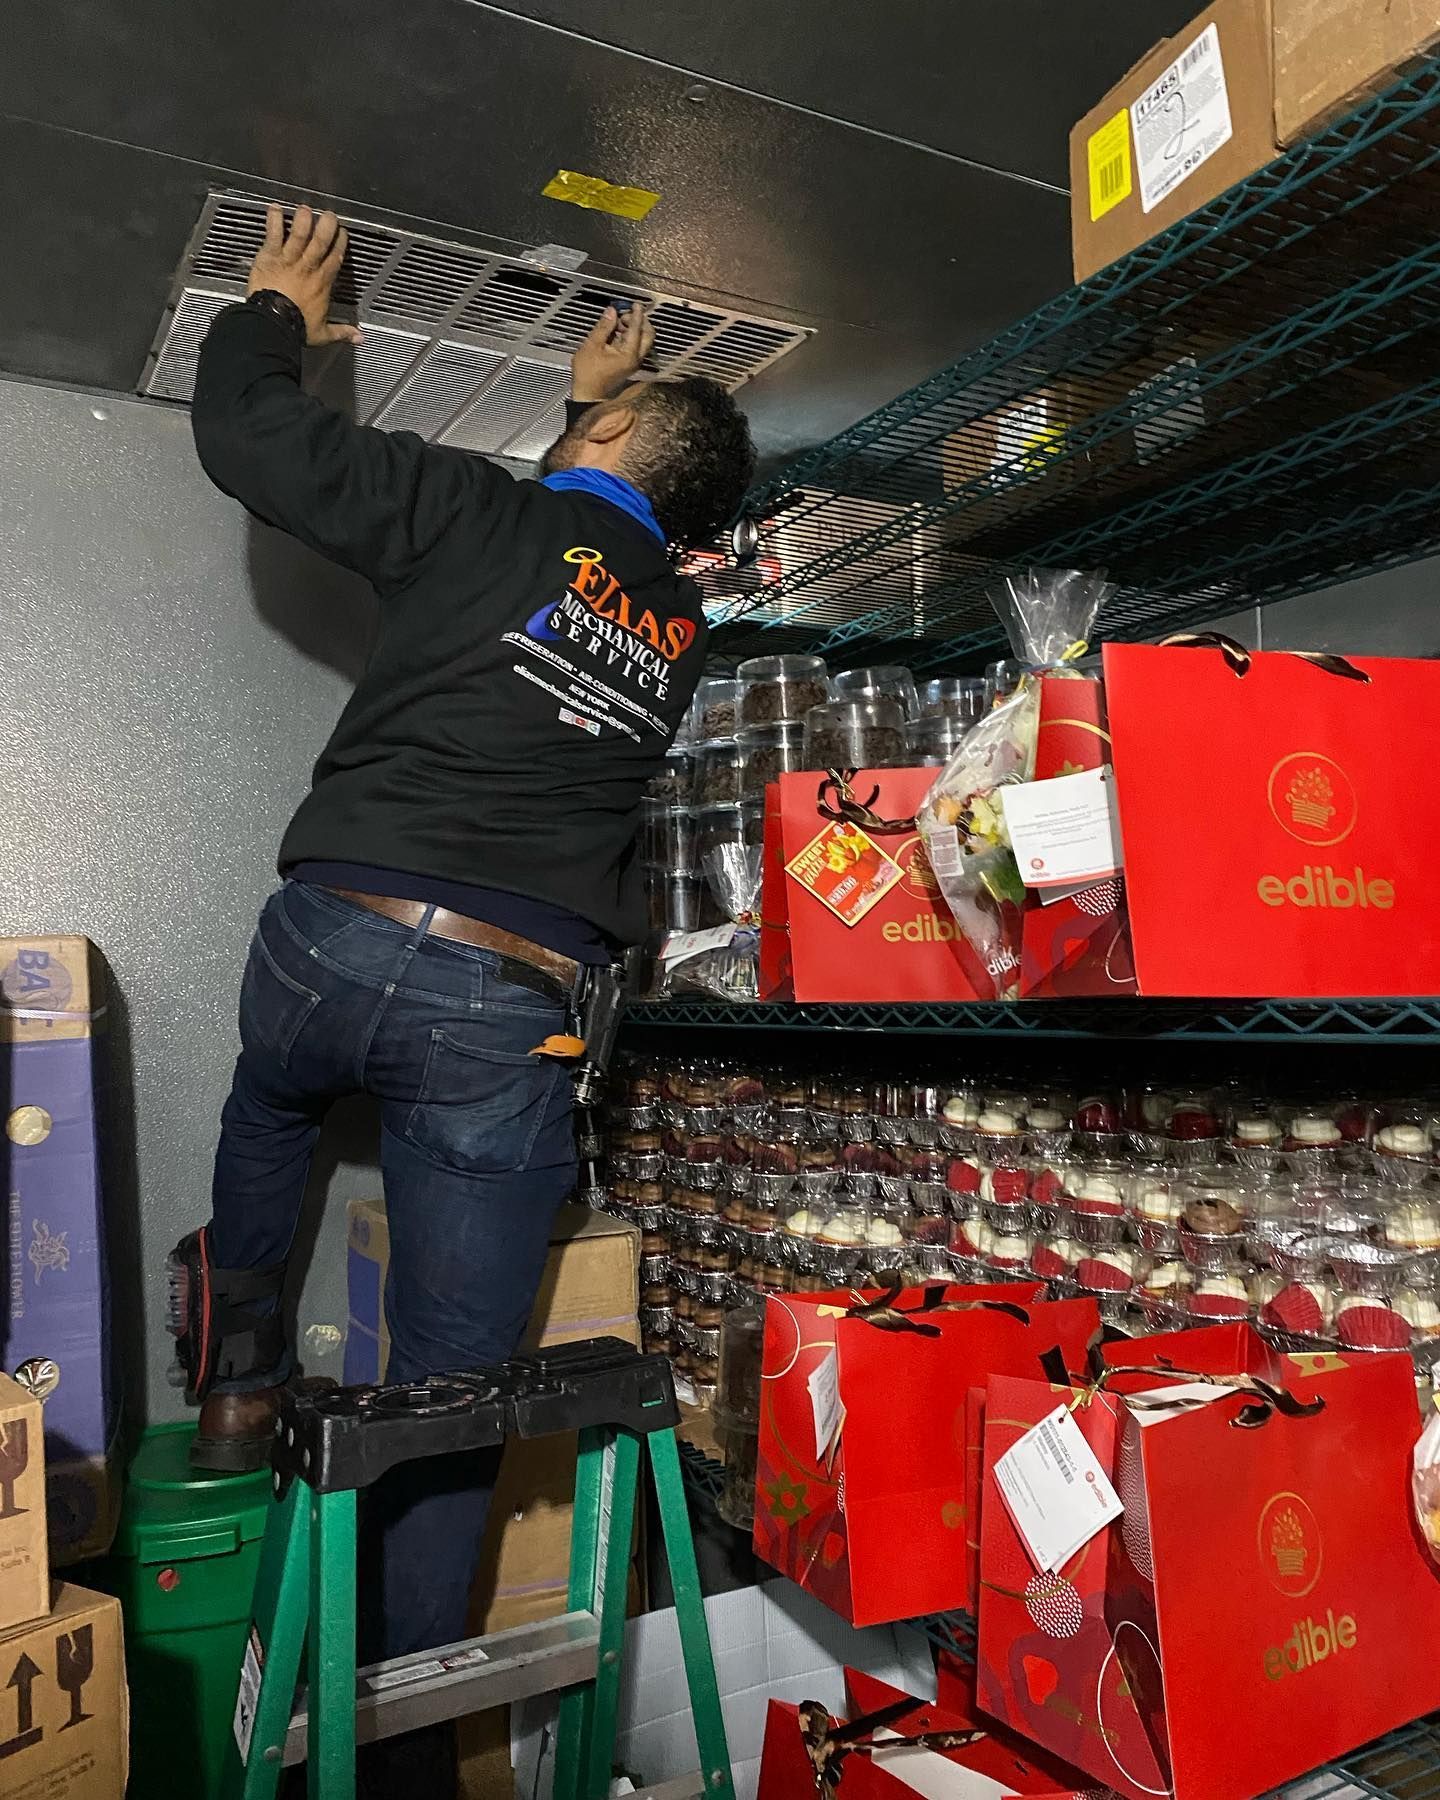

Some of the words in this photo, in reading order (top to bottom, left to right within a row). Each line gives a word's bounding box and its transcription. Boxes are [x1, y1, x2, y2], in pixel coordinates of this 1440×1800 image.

[568, 554, 686, 661] ELIAS
[549, 611, 669, 702] SERVICE
[558, 591, 671, 685] MECHANICAL
[586, 692, 611, 711] YORK
[792, 841, 826, 875] SWEET
[1257, 865, 1396, 909] edible
[882, 913, 961, 942] edibl
[986, 951, 1023, 976] dible
[1263, 1607, 1358, 1682] edible
